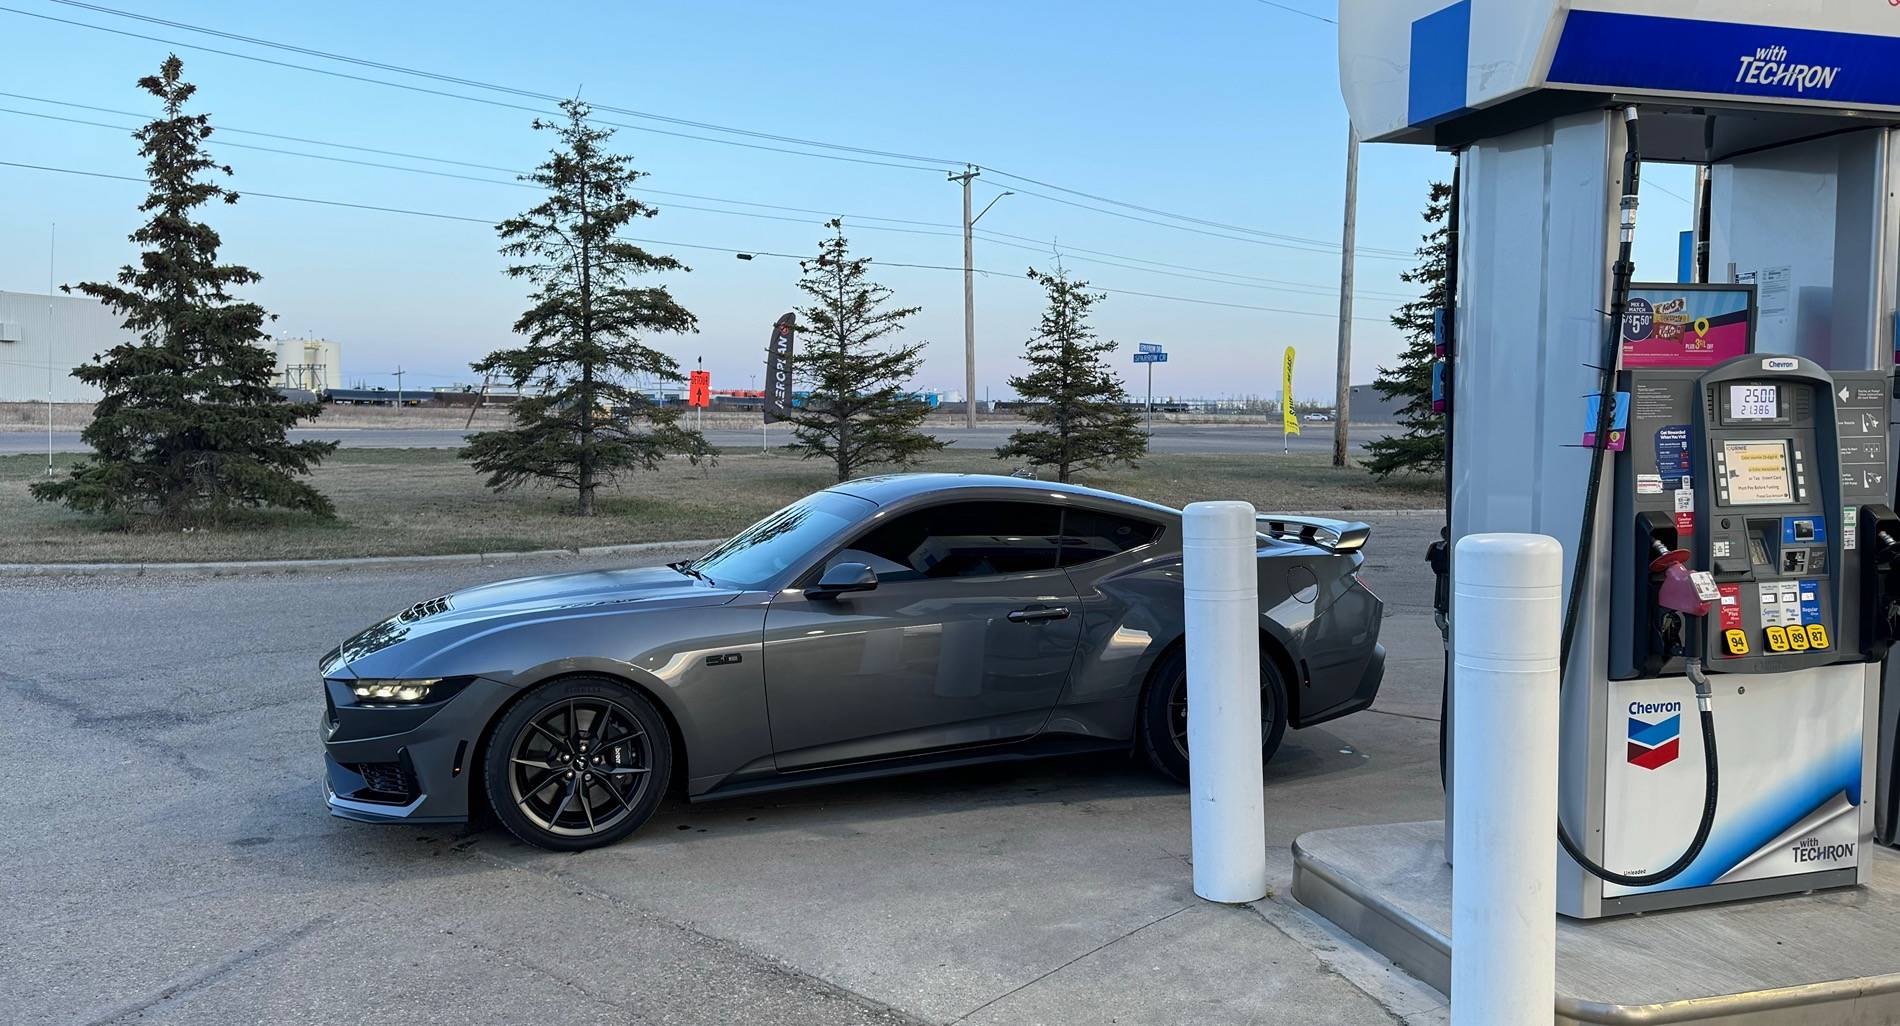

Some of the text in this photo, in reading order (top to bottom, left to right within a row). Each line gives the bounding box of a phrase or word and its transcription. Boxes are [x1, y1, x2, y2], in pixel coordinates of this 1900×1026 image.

[1756, 45, 1787, 61] with
[1736, 56, 1839, 92] TECHRON
[1772, 634, 1784, 645] 91
[1792, 633, 1804, 643] 89
[1812, 631, 1823, 642] 87
[1731, 637, 1744, 648] 94
[1628, 701, 1681, 715] Chevron
[1800, 837, 1819, 848] with
[1792, 843, 1855, 863] TECHRON
